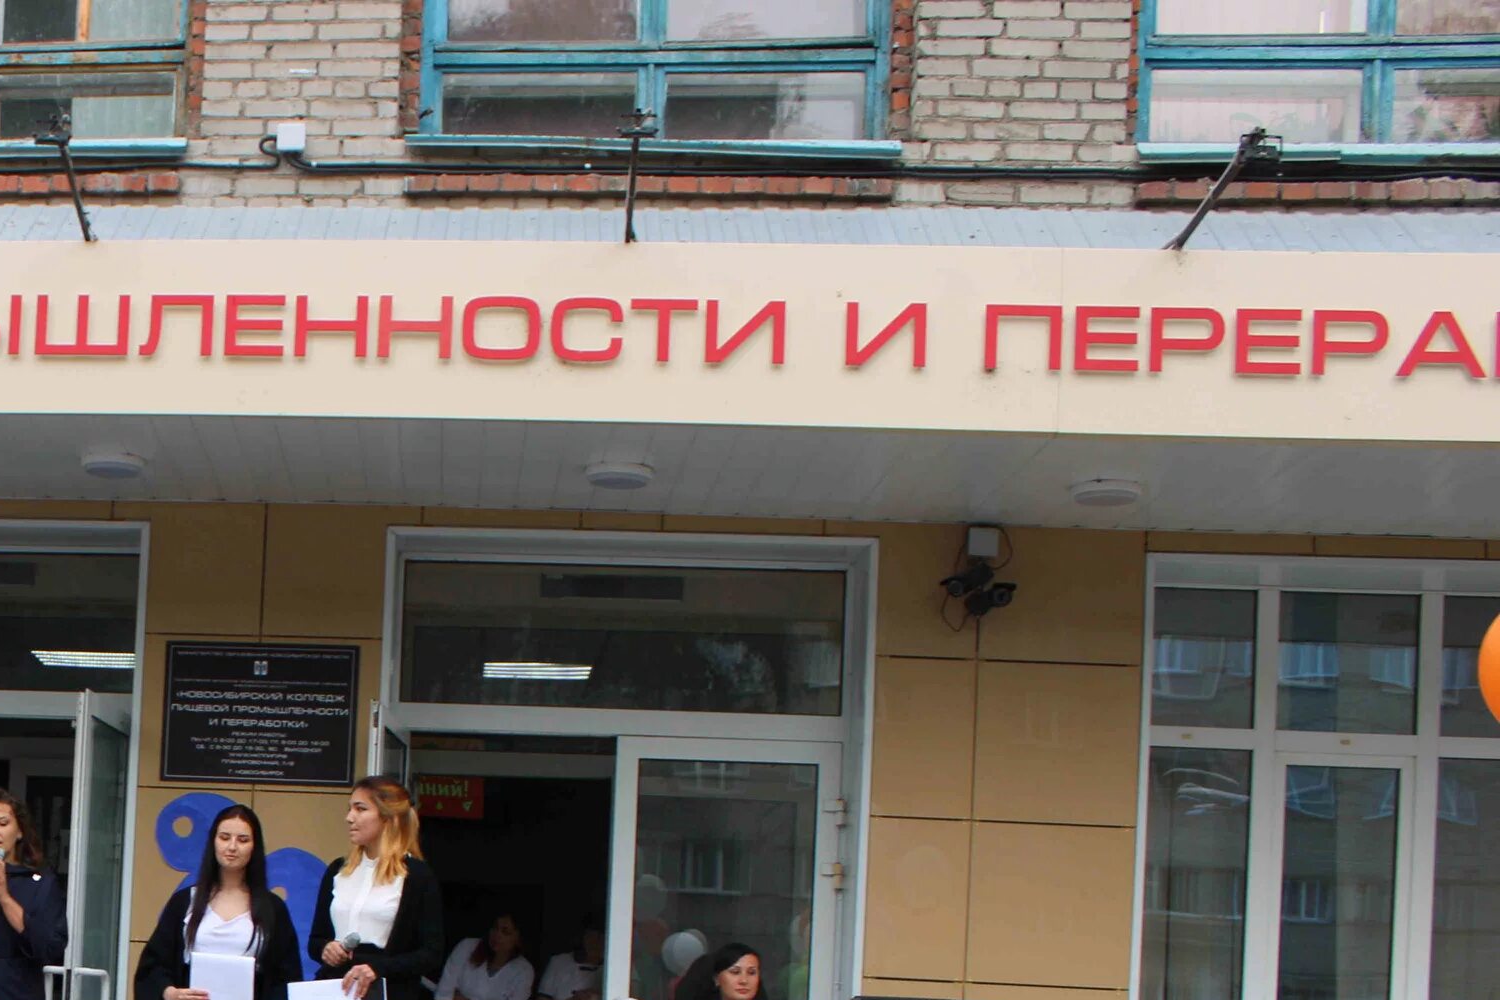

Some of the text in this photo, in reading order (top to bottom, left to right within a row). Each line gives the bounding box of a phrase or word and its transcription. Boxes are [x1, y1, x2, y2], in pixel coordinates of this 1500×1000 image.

[845, 301, 928, 368] И
[984, 303, 1500, 378] ПЕРЕРА
[286, 693, 346, 703] КОЛЛЕДЖ
[171, 703, 349, 716] ПИЩЕВОЙ ПРОМЫШЛЕННОСТИ
[208, 718, 219, 726] И
